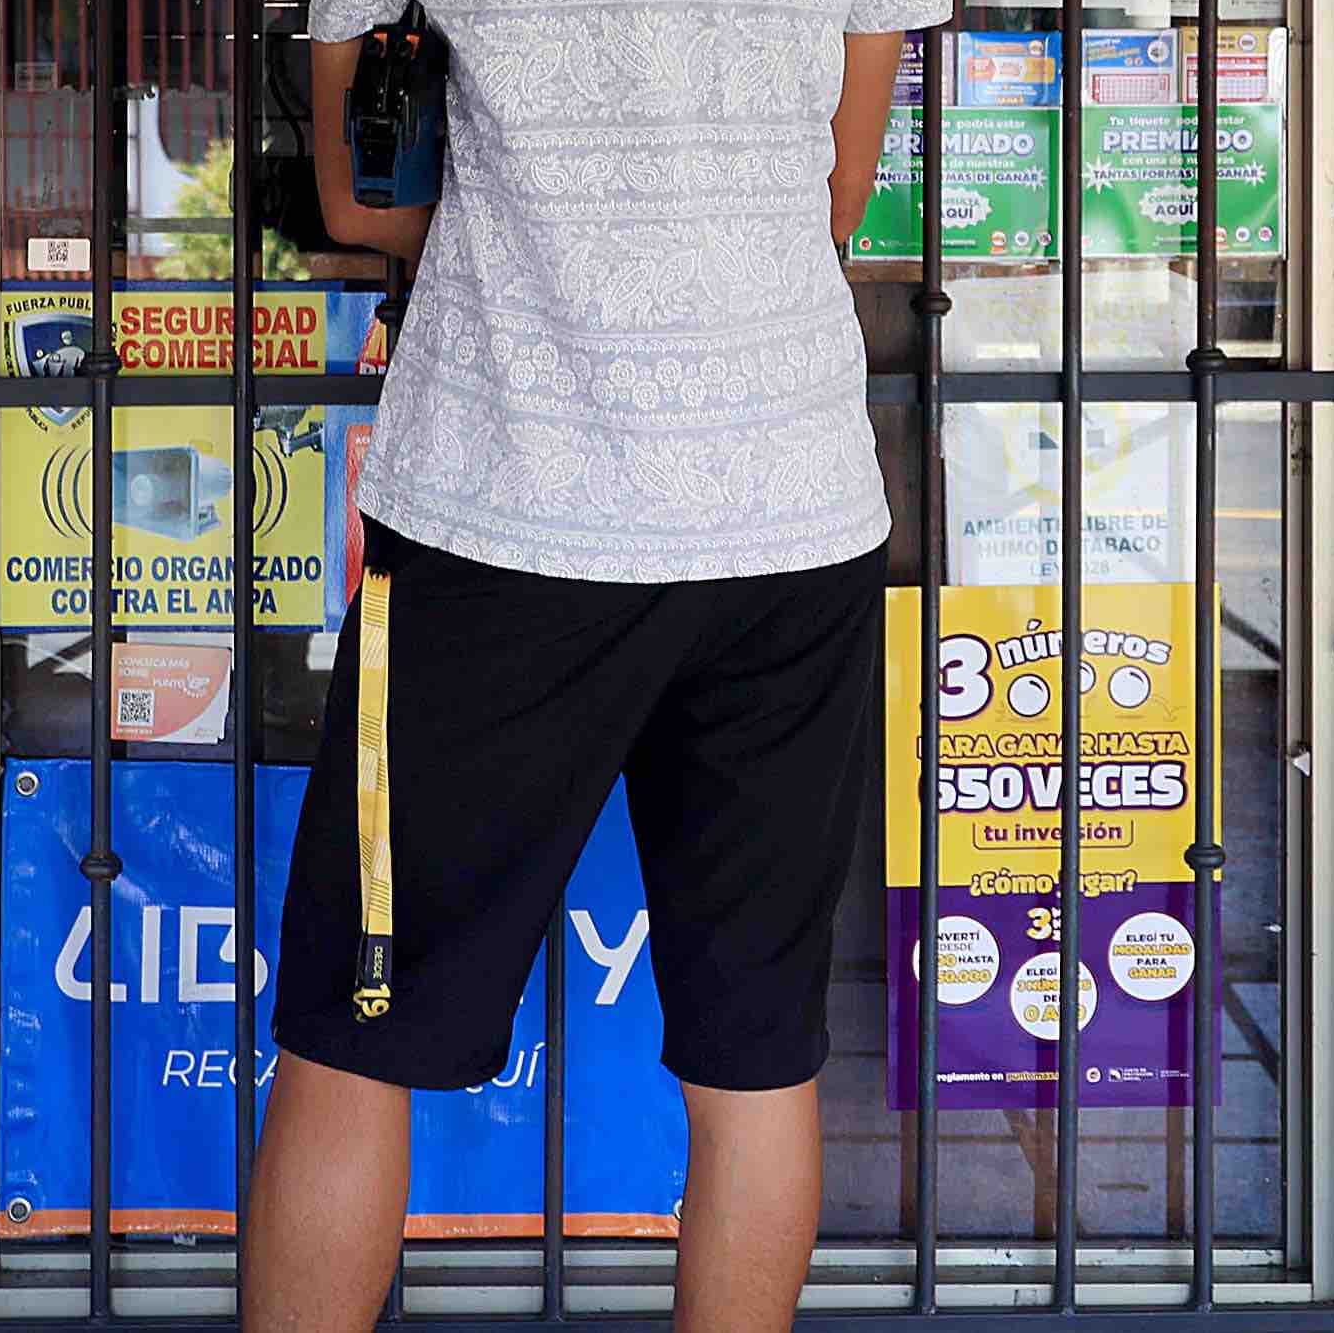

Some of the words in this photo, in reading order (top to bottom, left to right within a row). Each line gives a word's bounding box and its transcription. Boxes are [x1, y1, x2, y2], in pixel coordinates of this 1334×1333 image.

[1110, 116, 1124, 125] Tu
[1129, 115, 1170, 127] tiquete
[1123, 157, 1143, 165] con
[1146, 157, 1166, 165] una
[1169, 157, 1182, 165] de
[977, 172, 992, 182] DE
[996, 172, 1039, 182] GANAR
[1094, 169, 1138, 179] TANTAS
[1143, 168, 1192, 179] FORMAS
[1218, 168, 1259, 178] GANAR
[1155, 203, 1194, 216] AQUÍ
[1141, 513, 1167, 530] DE
[978, 541, 1036, 557] HUMO
[984, 824, 1008, 842] tu
[1014, 822, 1123, 841] invesión
[970, 868, 1053, 898] ¿Cómo
[1126, 932, 1157, 943] ELEGÍ
[1159, 933, 1175, 942] TU
[1113, 944, 1192, 956] MODALIDAD
[373, 945, 384, 979] DESDE
[959, 955, 994, 964] HASTA
[1136, 957, 1167, 967] PARA
[1027, 967, 1058, 977] ELEGÍ
[1129, 967, 1177, 980] GANAR
[360, 983, 391, 1018] 19
